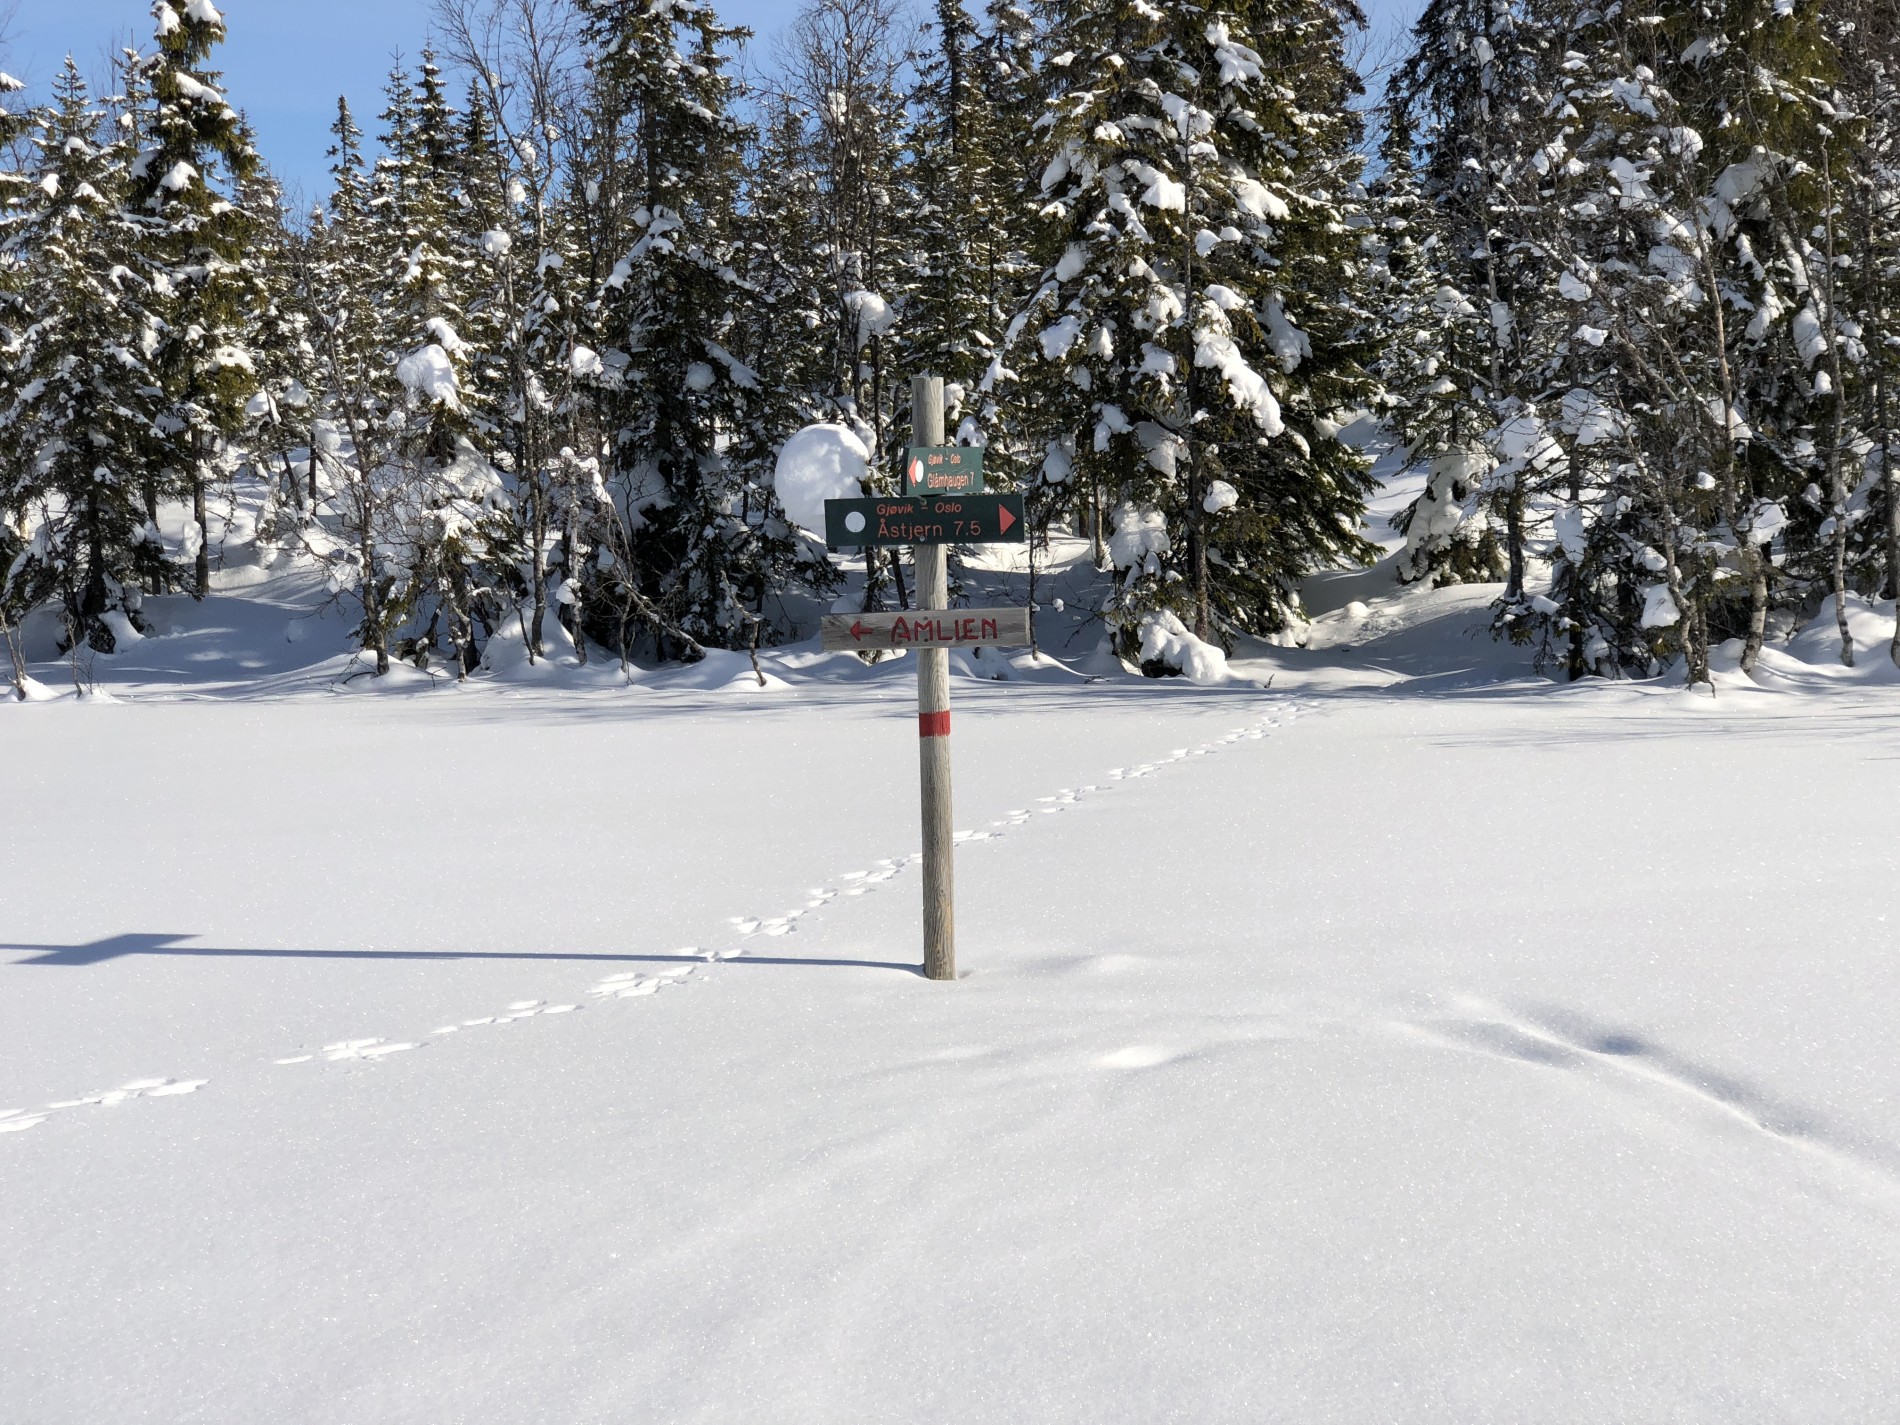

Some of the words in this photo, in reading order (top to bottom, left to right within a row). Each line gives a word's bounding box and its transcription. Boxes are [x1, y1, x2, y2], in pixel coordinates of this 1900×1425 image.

[927, 473, 969, 490] Glåmhaugen
[970, 471, 975, 486] 7
[876, 503, 913, 517] Gjøvik
[935, 502, 962, 514] Oslo
[878, 518, 942, 540] Åstjern
[953, 520, 981, 537] 7.5
[891, 615, 998, 642] AMLIEN
